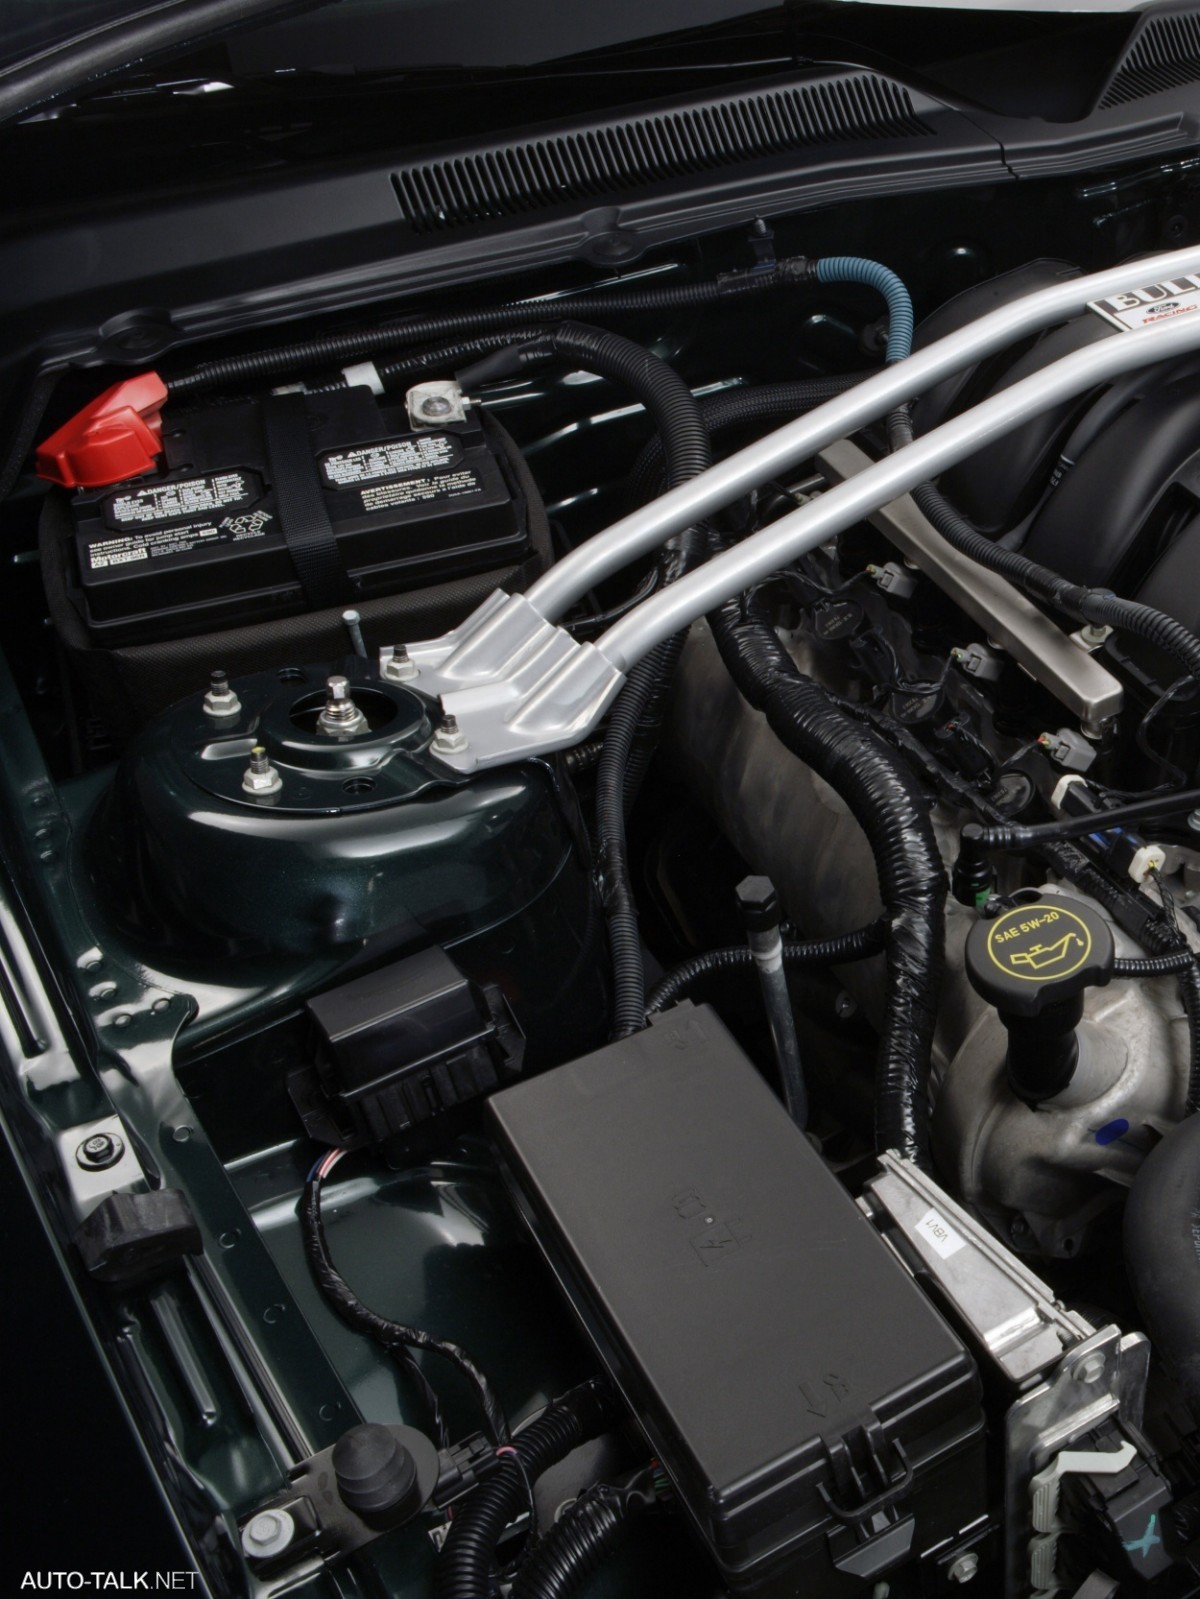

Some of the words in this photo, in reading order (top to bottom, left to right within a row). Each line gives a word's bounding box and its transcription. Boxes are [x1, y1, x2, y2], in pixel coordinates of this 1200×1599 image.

[1142, 304, 1198, 324] RACING
[356, 441, 412, 455] DANGER/POISON
[147, 479, 206, 495] DANGER/POISON
[89, 537, 133, 549] WARNING:
[164, 525, 192, 535] personal
[193, 521, 212, 529] injury
[150, 536, 179, 546] cranking
[125, 539, 145, 547] guide
[91, 548, 146, 563] Motorcraft
[994, 927, 1021, 943] SAE
[1020, 911, 1060, 933] 5W-20
